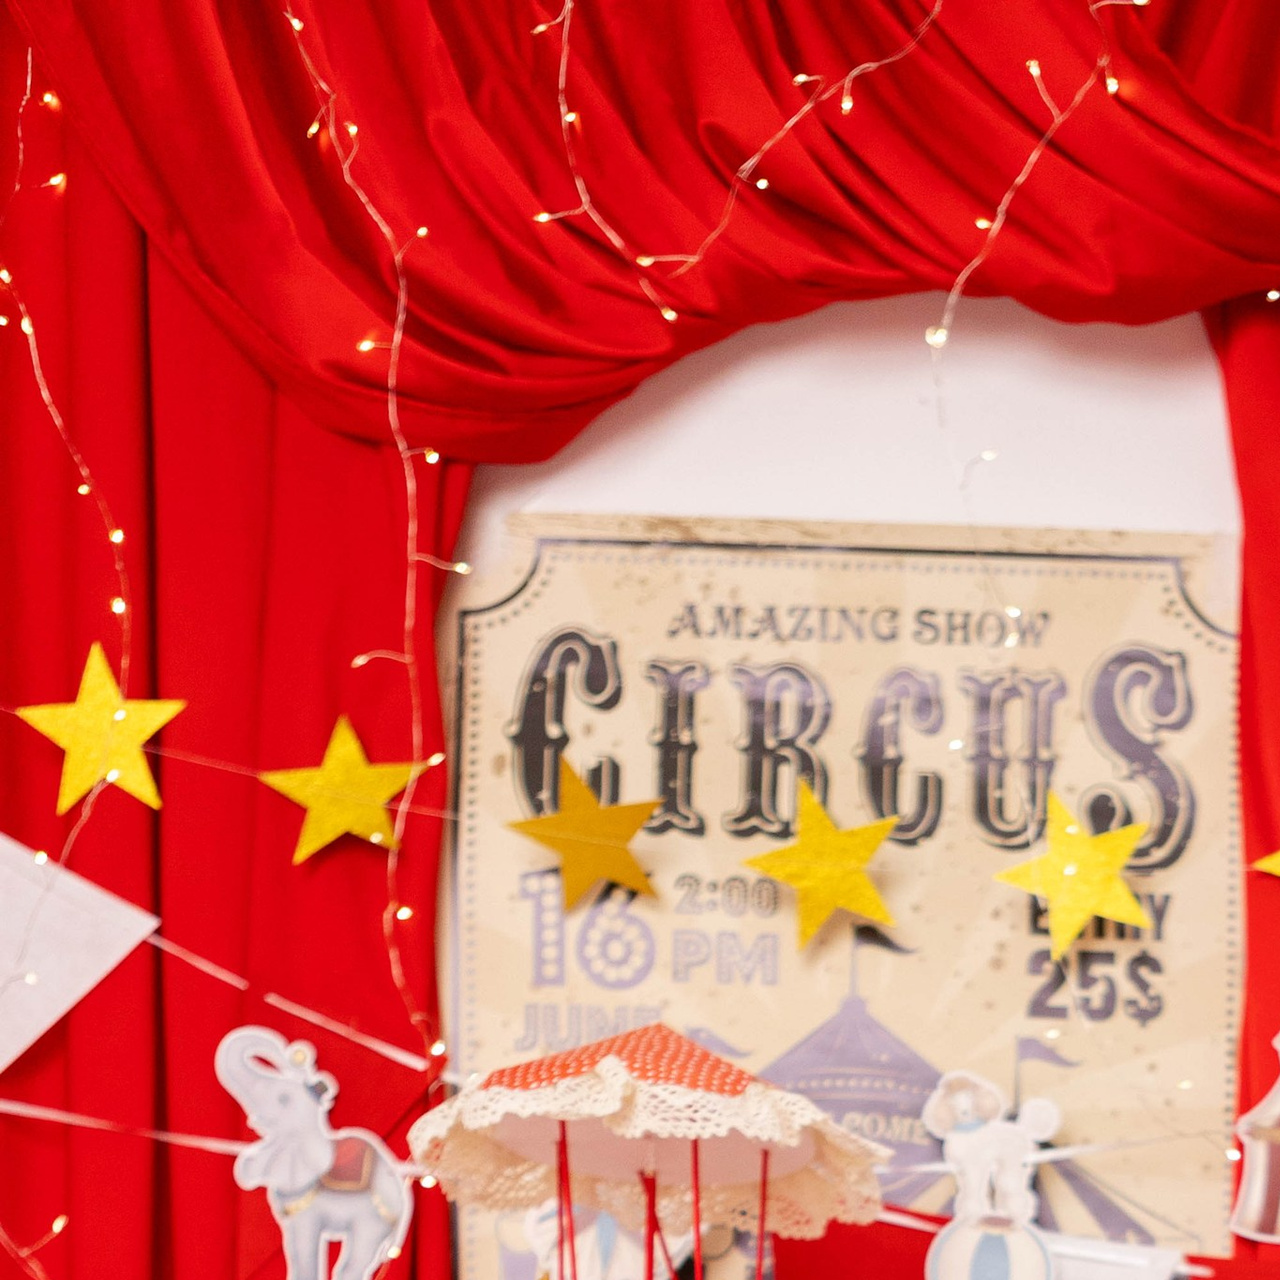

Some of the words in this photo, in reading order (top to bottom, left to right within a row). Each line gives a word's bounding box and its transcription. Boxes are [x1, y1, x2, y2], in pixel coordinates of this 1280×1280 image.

[667, 604, 899, 643] AMAZING
[912, 607, 1051, 649] SHOW
[506, 627, 1196, 872] CIRCUS
[519, 866, 656, 990] 16
[673, 872, 779, 919] 2:00
[671, 928, 779, 986] PM
[1026, 948, 1164, 1027] 25$
